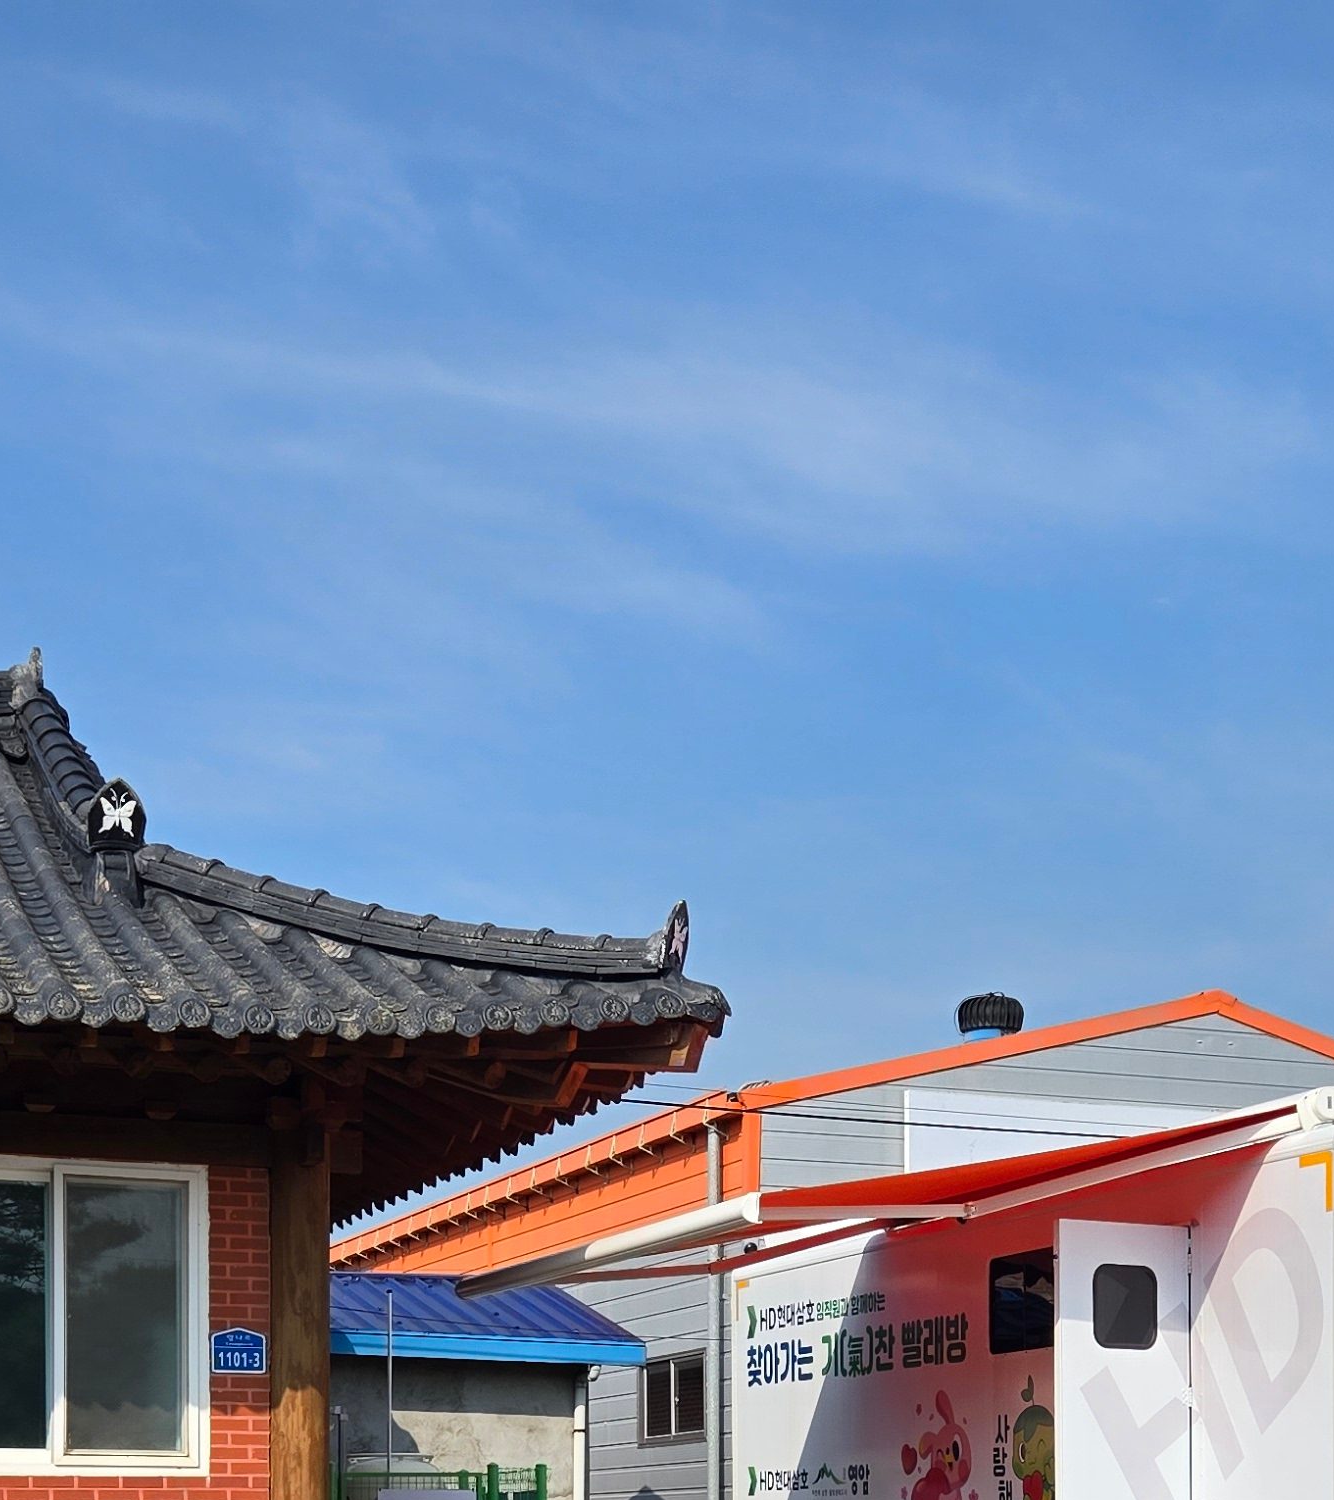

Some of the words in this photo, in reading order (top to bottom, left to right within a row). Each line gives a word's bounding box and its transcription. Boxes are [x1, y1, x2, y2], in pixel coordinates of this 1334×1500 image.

[759, 1299, 815, 1332] HD현대삼호
[816, 1297, 849, 1321] 임직원과
[218, 1352, 260, 1368] 1101-3
[747, 1339, 813, 1387] 찾아가는
[902, 1312, 968, 1368] 빨래방
[759, 1468, 809, 1491] HD현대삼호
[848, 1464, 870, 1496] 영암
